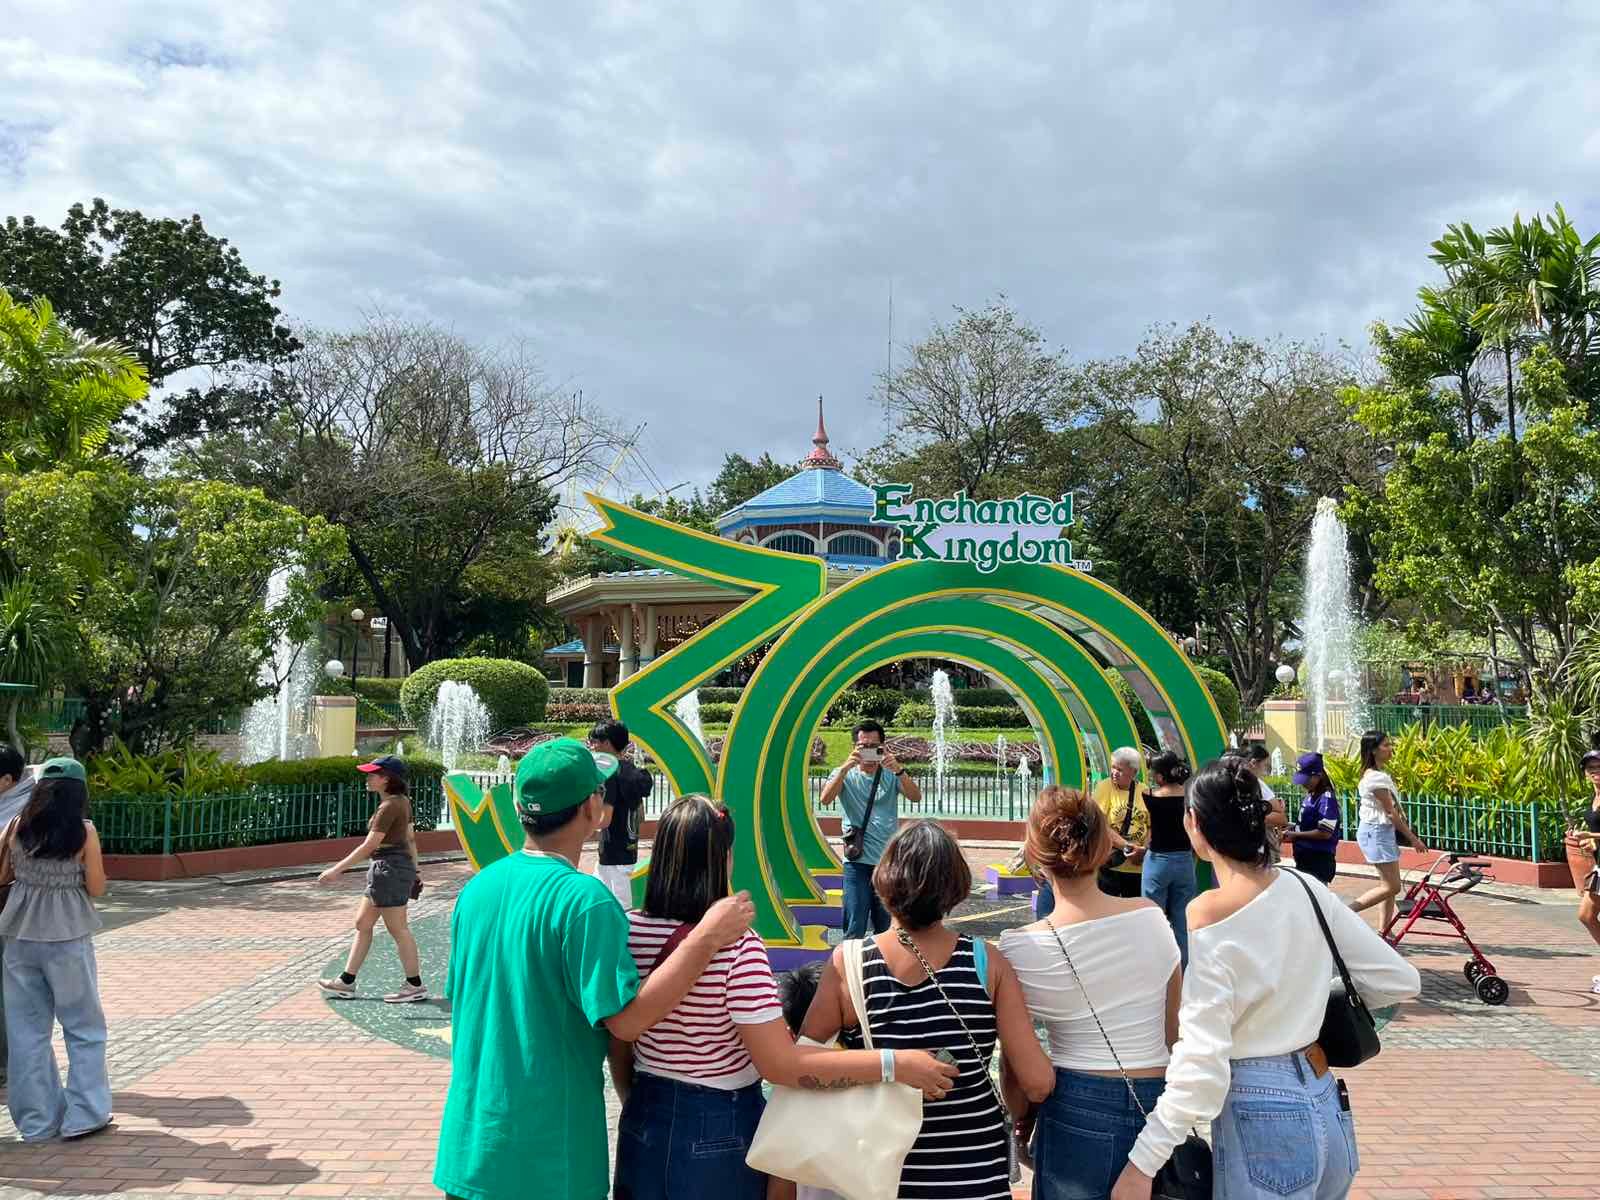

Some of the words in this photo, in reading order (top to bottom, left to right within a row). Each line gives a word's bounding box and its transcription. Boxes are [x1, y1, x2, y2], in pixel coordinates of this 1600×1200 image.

[872, 483, 1073, 526] Enchanted
[899, 523, 1073, 572] Kingdom
[1075, 560, 1091, 570] TM
